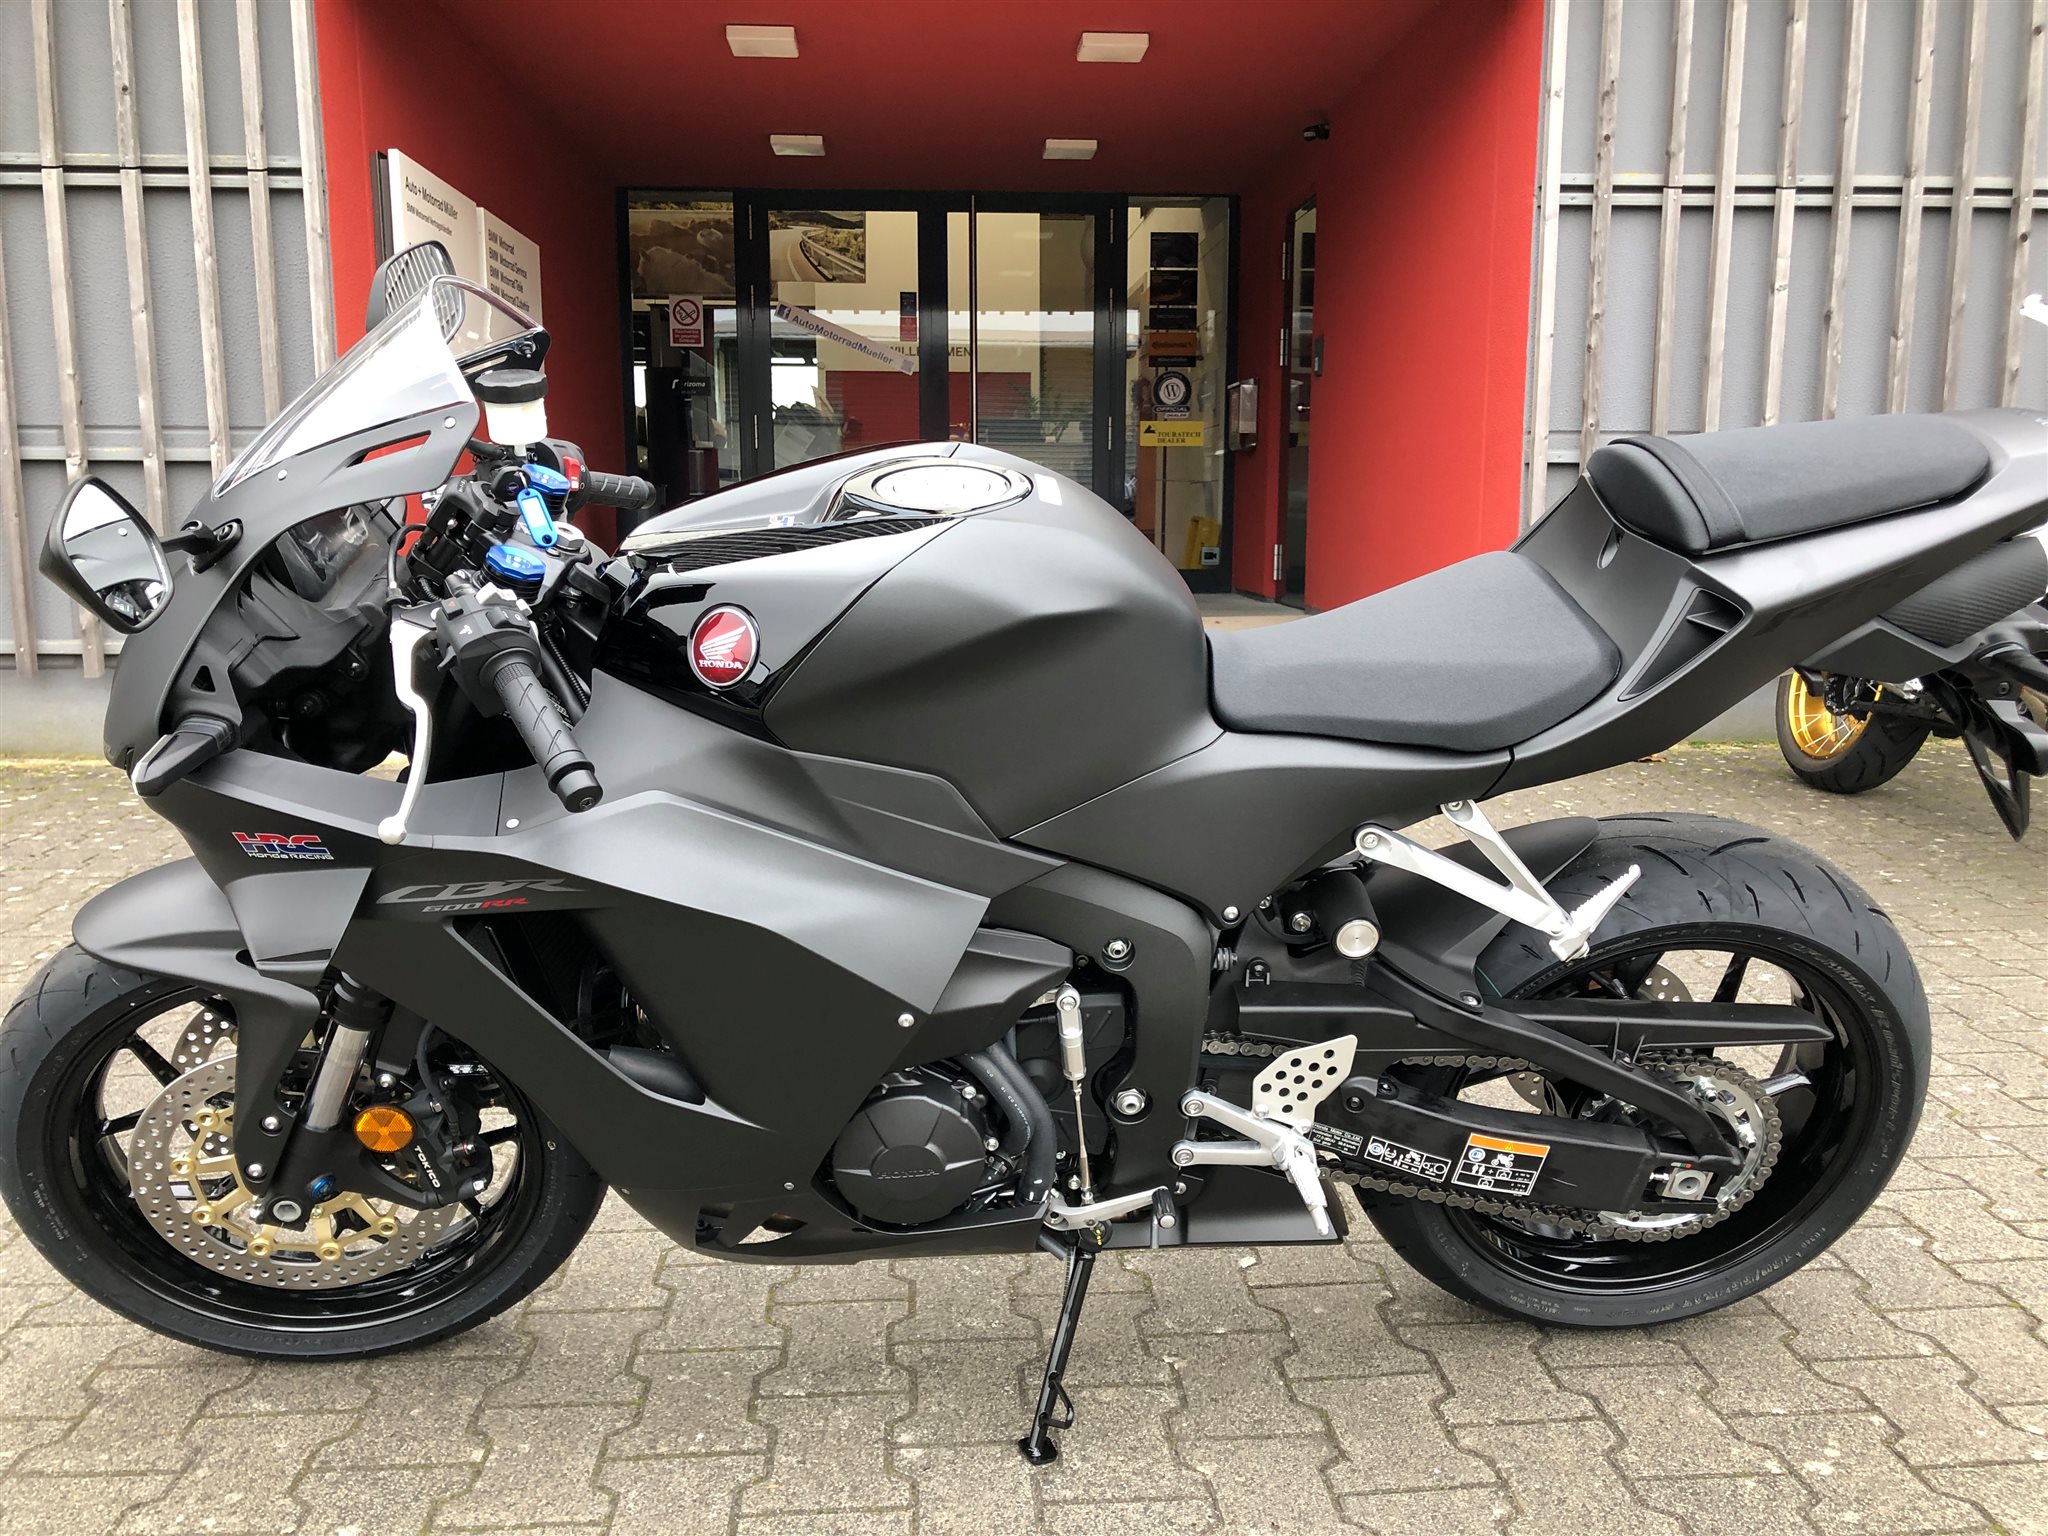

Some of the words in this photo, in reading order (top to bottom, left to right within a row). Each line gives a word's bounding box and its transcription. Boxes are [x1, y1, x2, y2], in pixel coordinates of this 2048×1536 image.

[405, 175, 418, 196] Auto
[792, 315, 894, 365] AutoMotorradMueller
[683, 380, 706, 388] rizoma
[698, 659, 744, 670] HONDA
[231, 831, 331, 855] HRC
[247, 851, 289, 859] Honda
[375, 878, 589, 904] CBR
[421, 896, 529, 913] 600RR
[414, 1145, 441, 1188] TOKICO
[877, 1168, 940, 1180] HONDA
